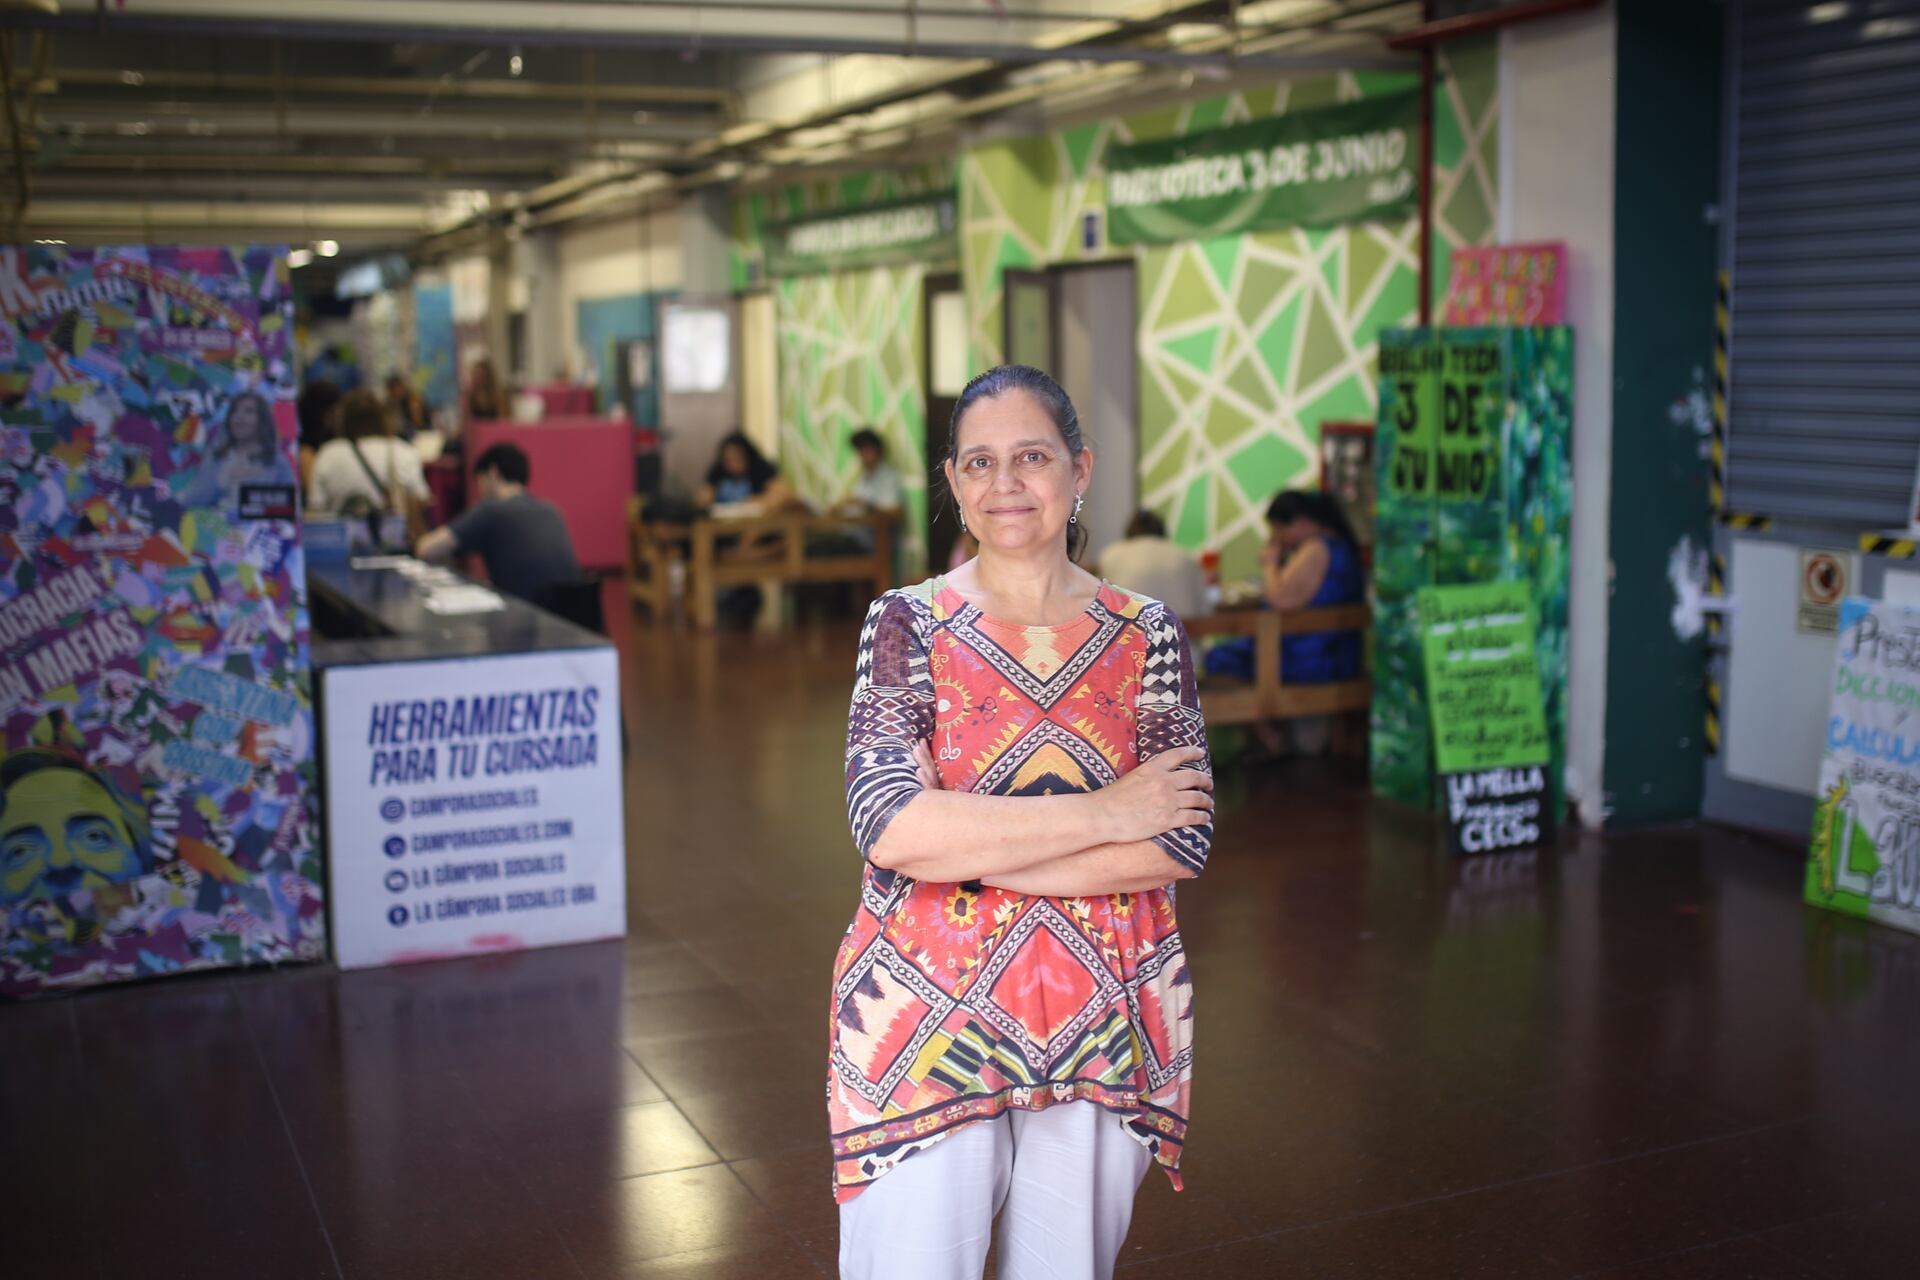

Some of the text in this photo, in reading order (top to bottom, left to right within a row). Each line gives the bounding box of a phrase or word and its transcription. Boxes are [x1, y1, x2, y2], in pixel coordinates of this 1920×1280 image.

[1395, 382, 1482, 436] 3 DE
[25, 608, 140, 692] MAFIAS
[369, 688, 598, 747] HERRAMIENTAS
[370, 732, 598, 786] PARA TU CURSADA
[1475, 766, 1545, 798] MELLA
[412, 868, 431, 888] LA
[414, 902, 433, 923] LA
